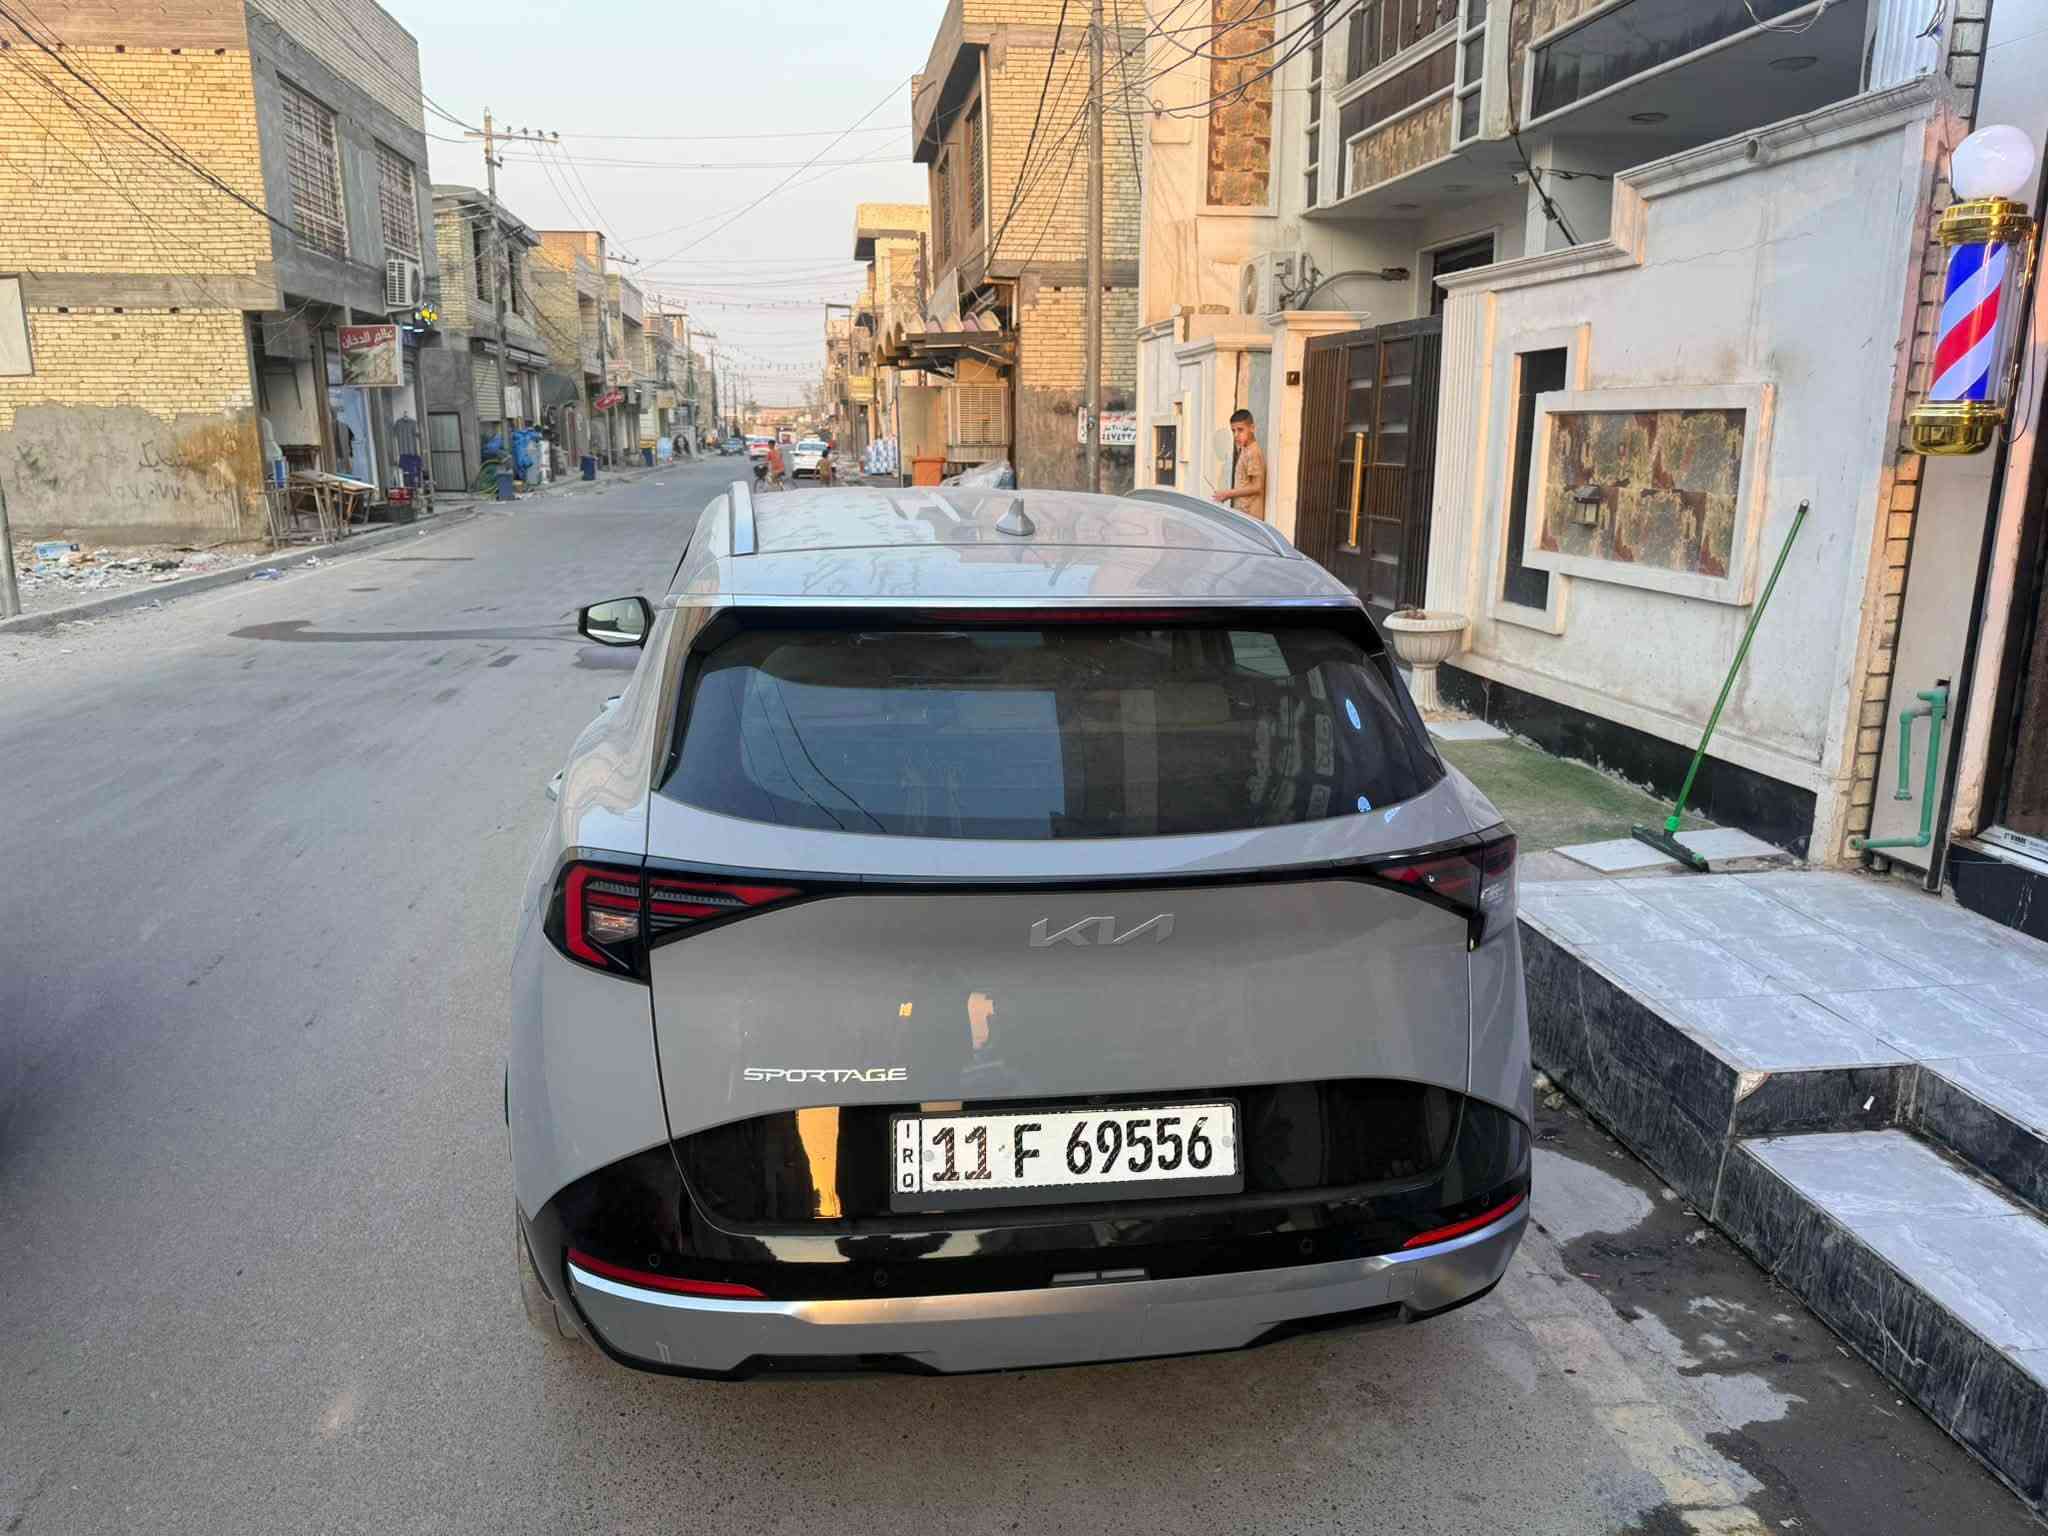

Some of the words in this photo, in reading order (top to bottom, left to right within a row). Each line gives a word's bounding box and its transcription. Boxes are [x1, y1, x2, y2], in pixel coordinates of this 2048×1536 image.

[1030, 913, 1175, 947] KIA
[743, 1067, 908, 1082] SPORTAGE
[932, 1125, 992, 1182] 11
[1014, 1122, 1042, 1178] F
[1065, 1116, 1213, 1175] 69556
